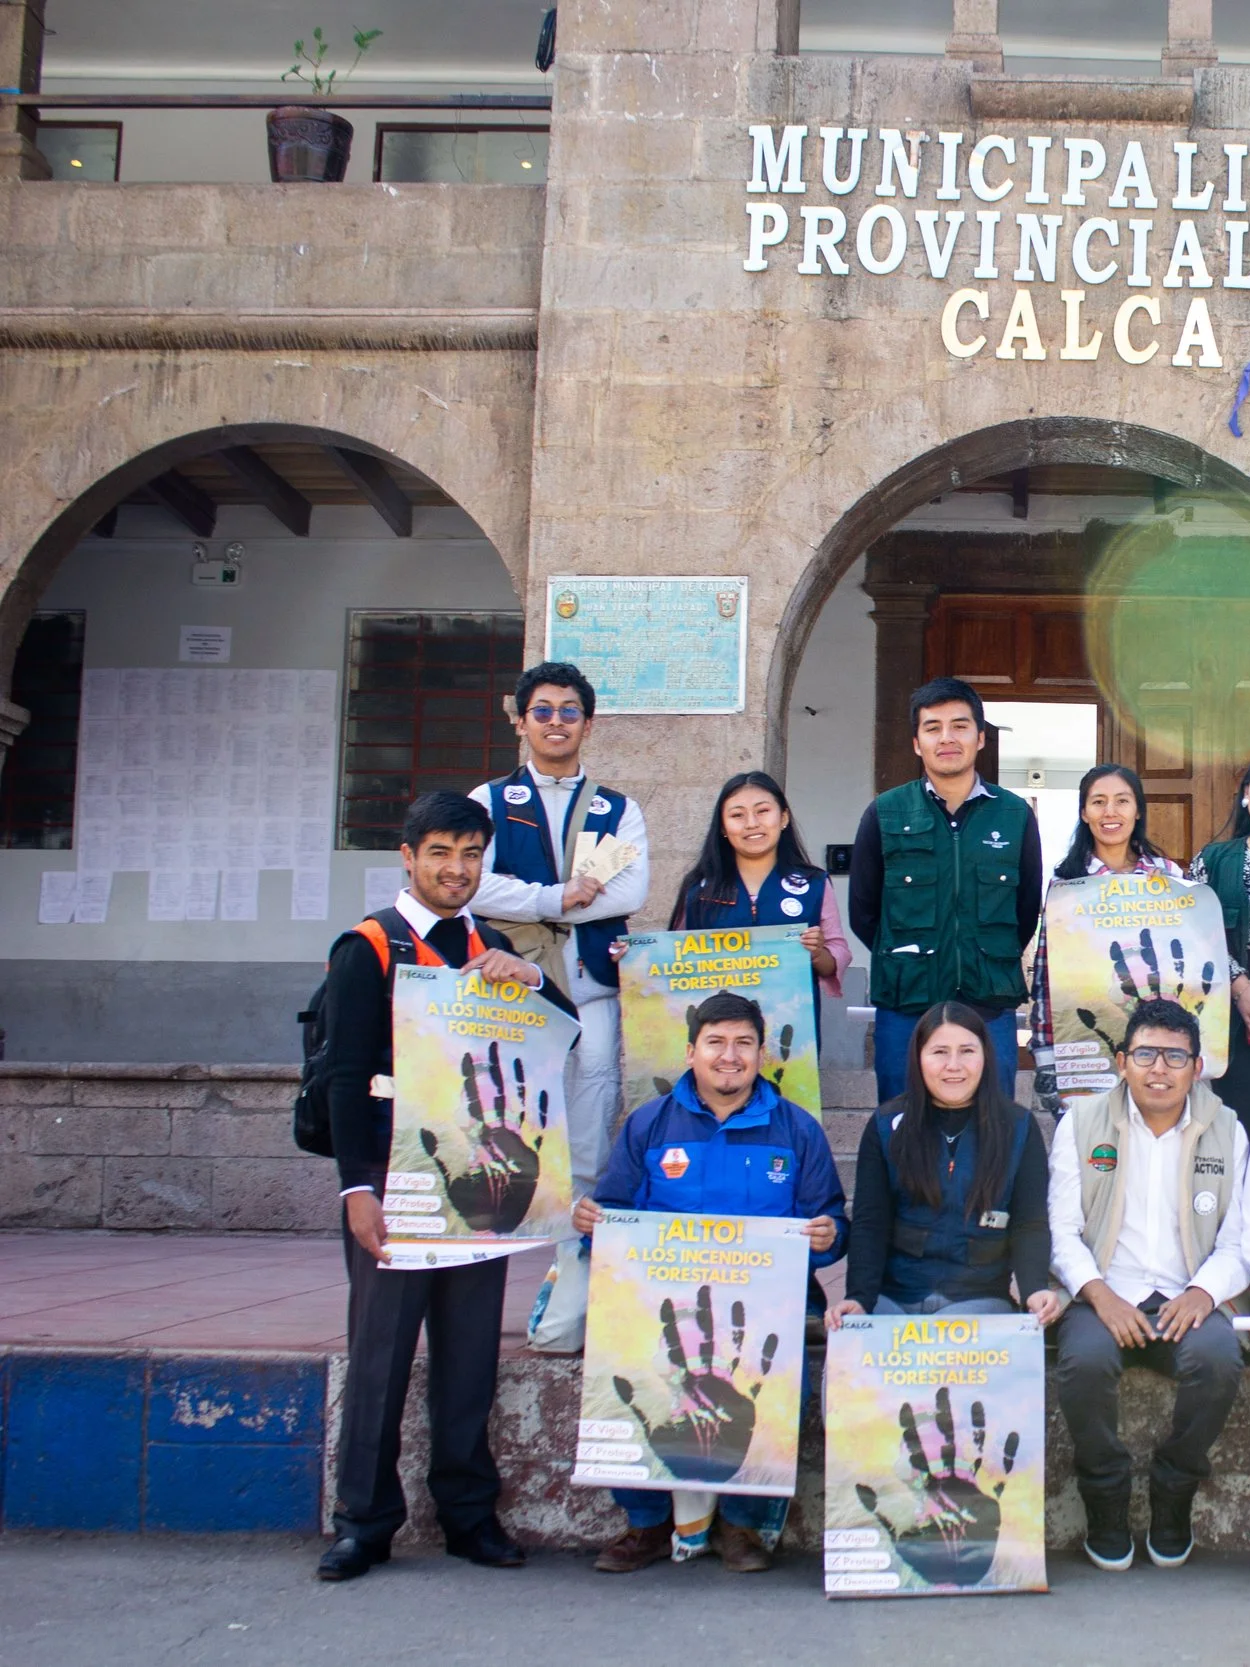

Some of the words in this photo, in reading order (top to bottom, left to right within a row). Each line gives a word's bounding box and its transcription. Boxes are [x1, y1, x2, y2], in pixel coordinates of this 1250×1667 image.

[941, 288, 1223, 368] CALCA
[612, 582, 673, 592] MUNICIPAL
[681, 582, 696, 592] DE
[1099, 876, 1171, 902] ¡ALTO!
[1074, 904, 1086, 916] A
[1089, 902, 1117, 914] LOS
[1120, 895, 1195, 914] INCENDIOS
[1093, 913, 1183, 929] FORESTALES
[674, 930, 751, 961] ¡ALTO!
[649, 964, 662, 976] A
[664, 960, 694, 975] LOS
[696, 954, 779, 973] INCENDIOS
[455, 974, 530, 1005] ¡ALTO!
[669, 972, 761, 991] FORESTALES
[426, 1002, 440, 1016] A
[442, 1002, 474, 1018] LOS
[476, 1004, 548, 1027] INCENDIOS
[448, 1020, 525, 1043] FORESTALES
[1069, 1045, 1097, 1055] Vigila
[1070, 1061, 1107, 1070] Protege
[1194, 1155, 1225, 1163] Practical
[1194, 1163, 1225, 1176] ACTION
[402, 1176, 432, 1188] Vigila
[400, 1196, 438, 1210] Protege
[397, 1218, 442, 1229] Denuncia
[611, 1216, 640, 1224] CALCA
[658, 1218, 744, 1247] ¡ALTO!
[625, 1247, 639, 1261] A
[642, 1247, 676, 1262] LOS
[680, 1250, 773, 1267] INCENDIOS
[647, 1266, 750, 1284] FORESTALES
[844, 1322, 874, 1330] CALCA
[892, 1319, 979, 1351] ¡ALTO!
[862, 1354, 875, 1366] A
[878, 1351, 912, 1366] LOS
[916, 1350, 1010, 1366] INCENDIOS
[883, 1368, 989, 1385] FORESTALES
[597, 1425, 629, 1437] Vigila
[595, 1446, 638, 1460] Protege
